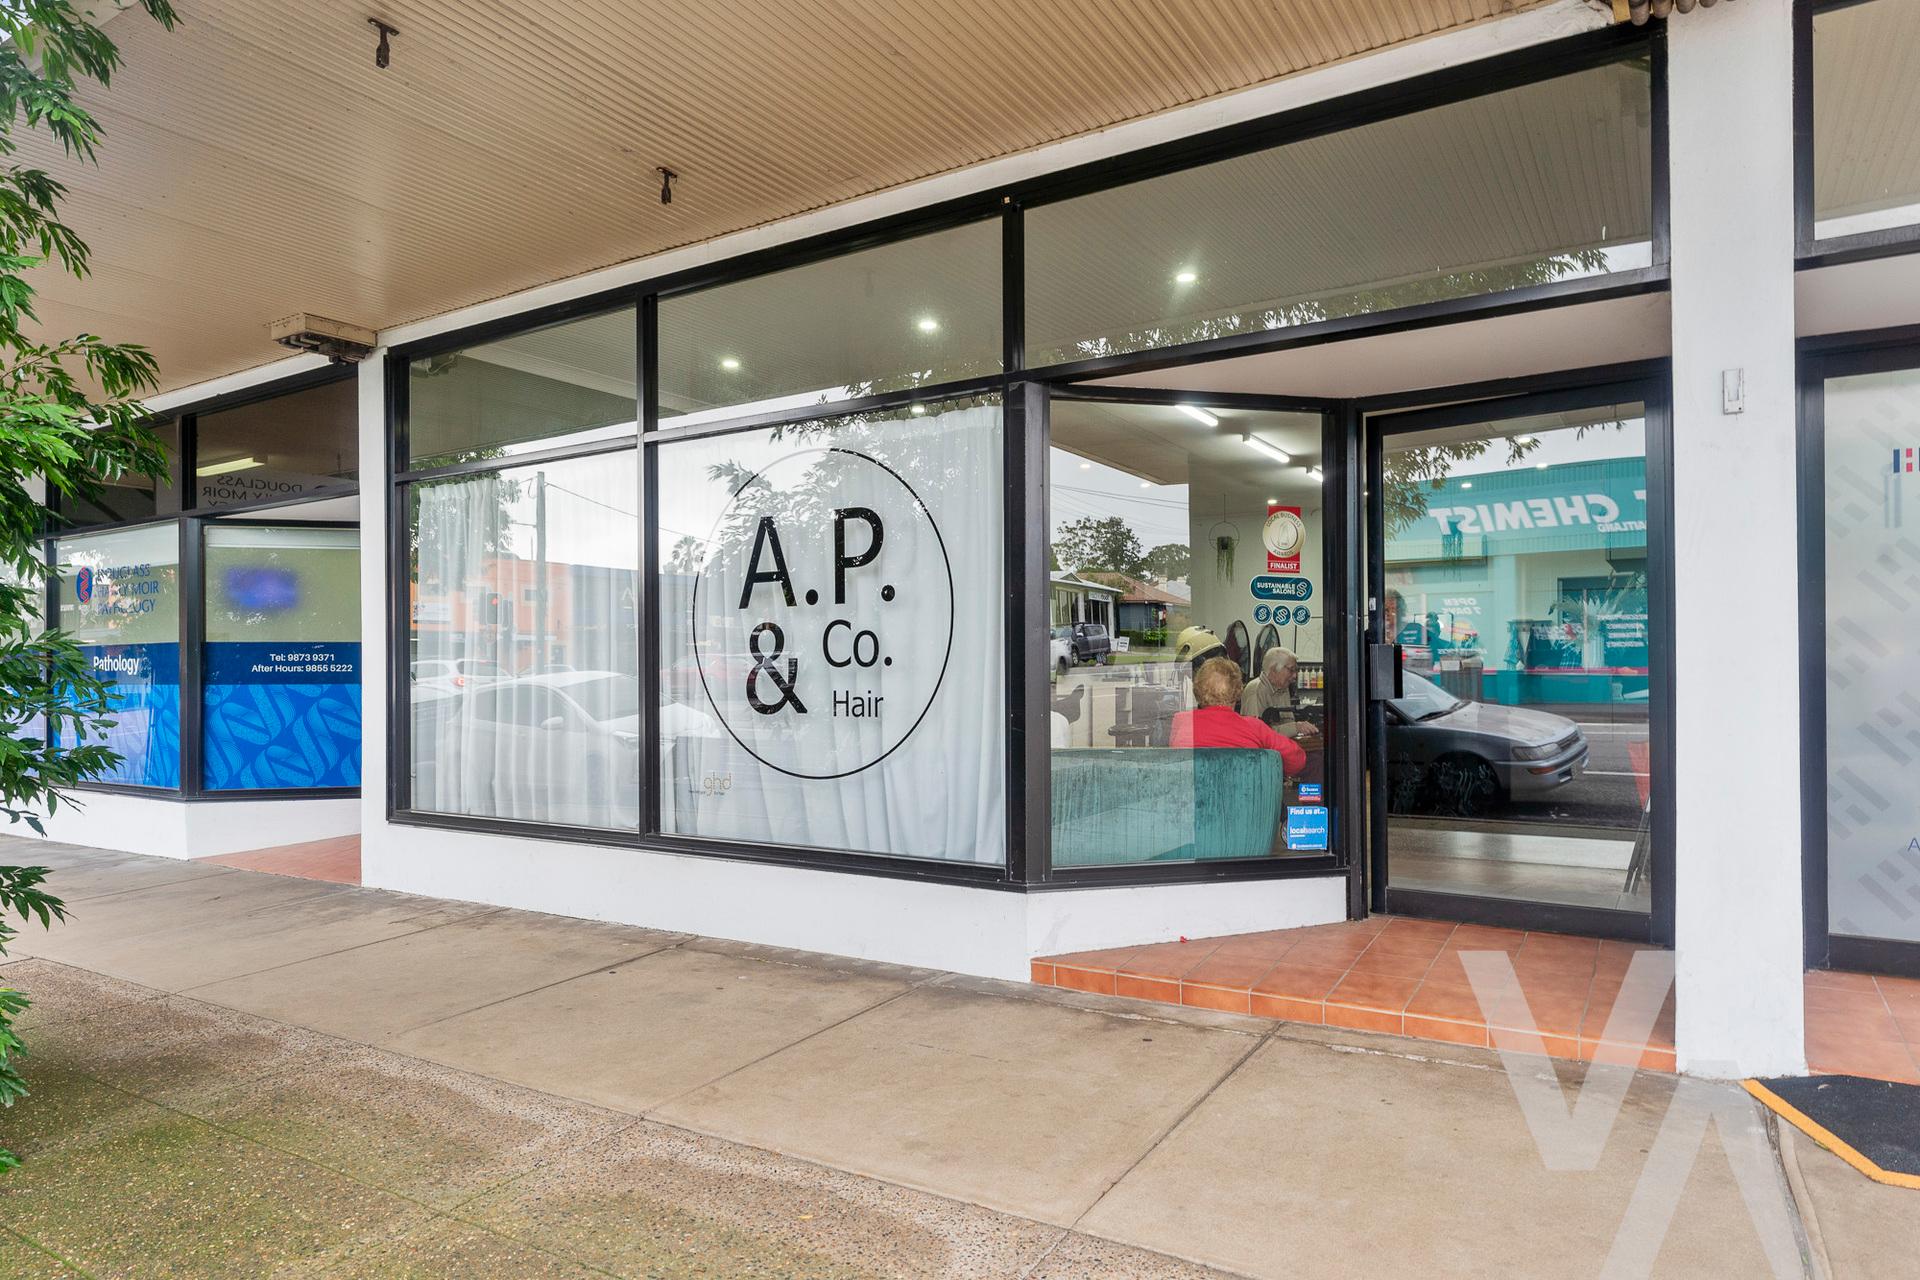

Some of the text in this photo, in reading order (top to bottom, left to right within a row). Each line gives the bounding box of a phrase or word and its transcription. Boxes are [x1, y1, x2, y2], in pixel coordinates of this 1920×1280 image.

[738, 506, 895, 609] A.P.
[1272, 587, 1296, 595] SALONS
[93, 654, 140, 675] Pathology
[251, 664, 353, 673] After Hours: 9855 5222
[269, 653, 335, 662] Tel: 9873 9371
[746, 619, 893, 714] & Co.
[832, 689, 884, 718] Hair
[703, 771, 732, 797] ghd
